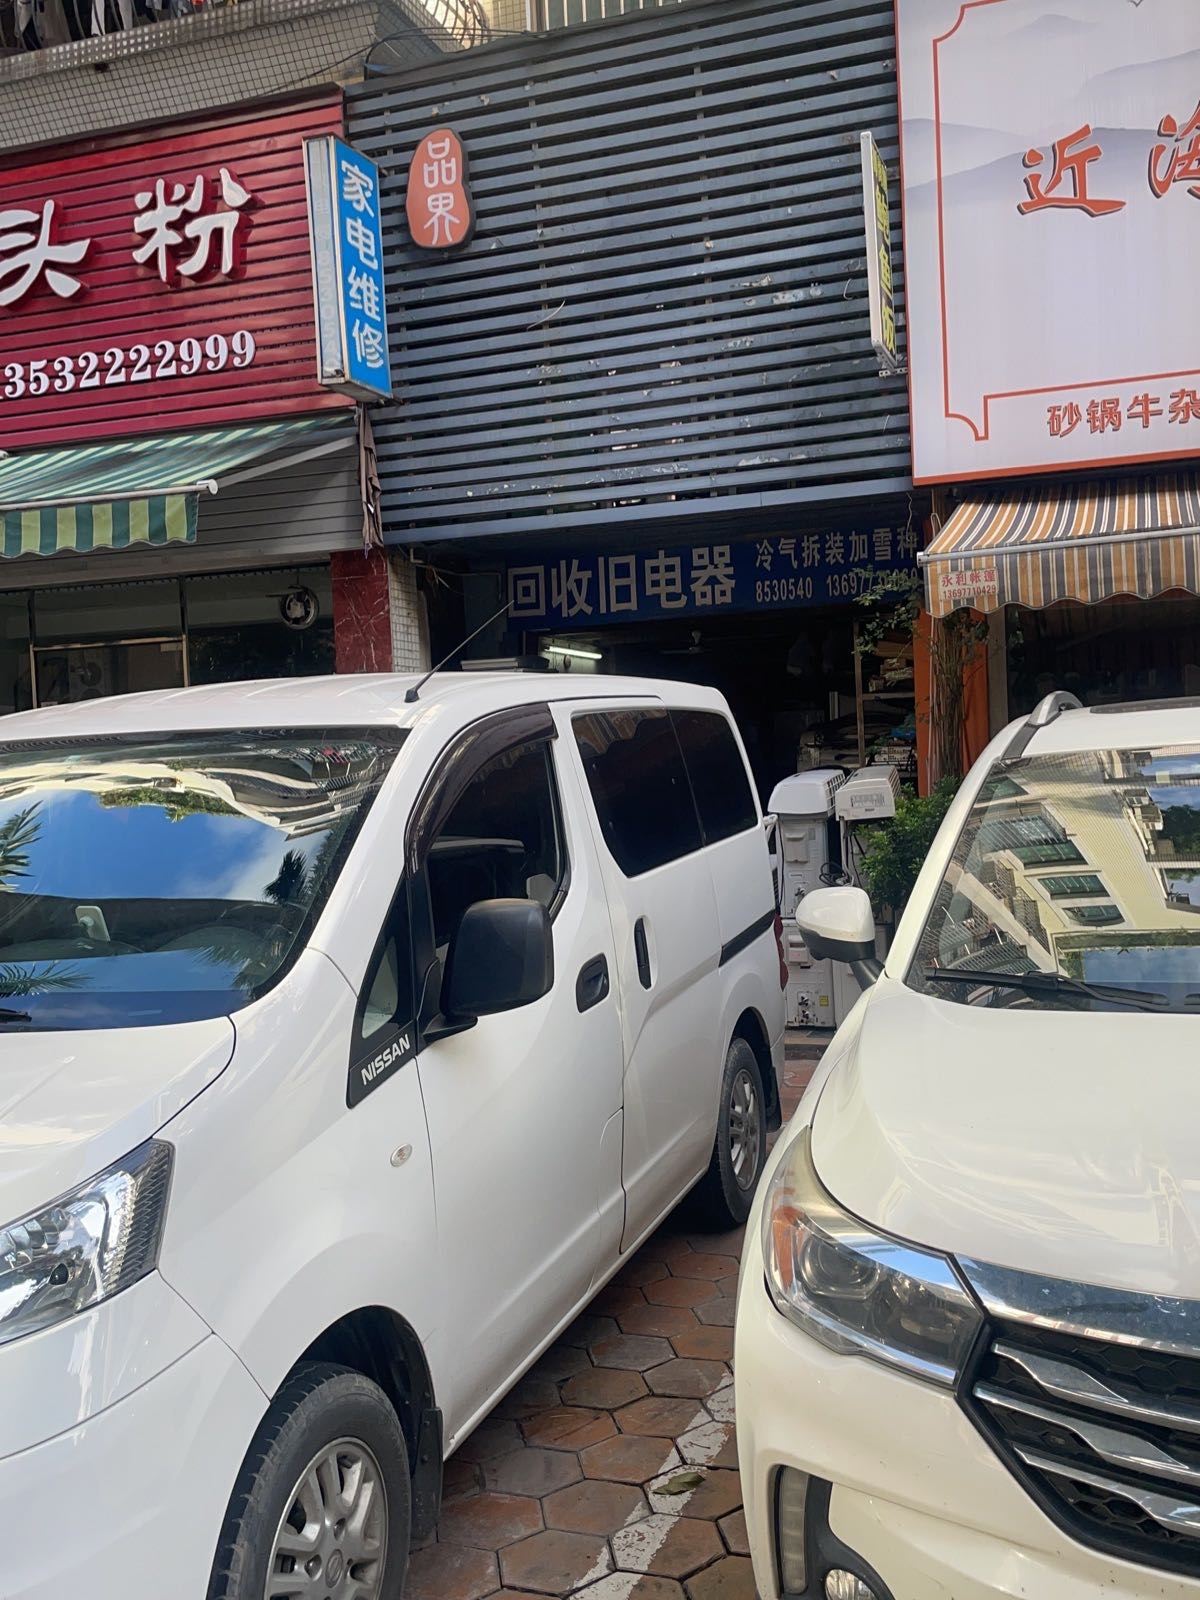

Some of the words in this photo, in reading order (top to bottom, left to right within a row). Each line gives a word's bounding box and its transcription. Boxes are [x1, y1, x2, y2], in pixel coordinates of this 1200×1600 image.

[423, 138, 460, 245] 品界
[341, 159, 384, 369] 家电维修
[0, 330, 256, 400] 3532222999
[756, 526, 918, 571] 冷气拆装加雪种
[508, 545, 736, 619] 回收旧电器
[756, 577, 812, 603] 8530540
[943, 585, 997, 599] 13697710429
[361, 1033, 411, 1086] NISSAN
